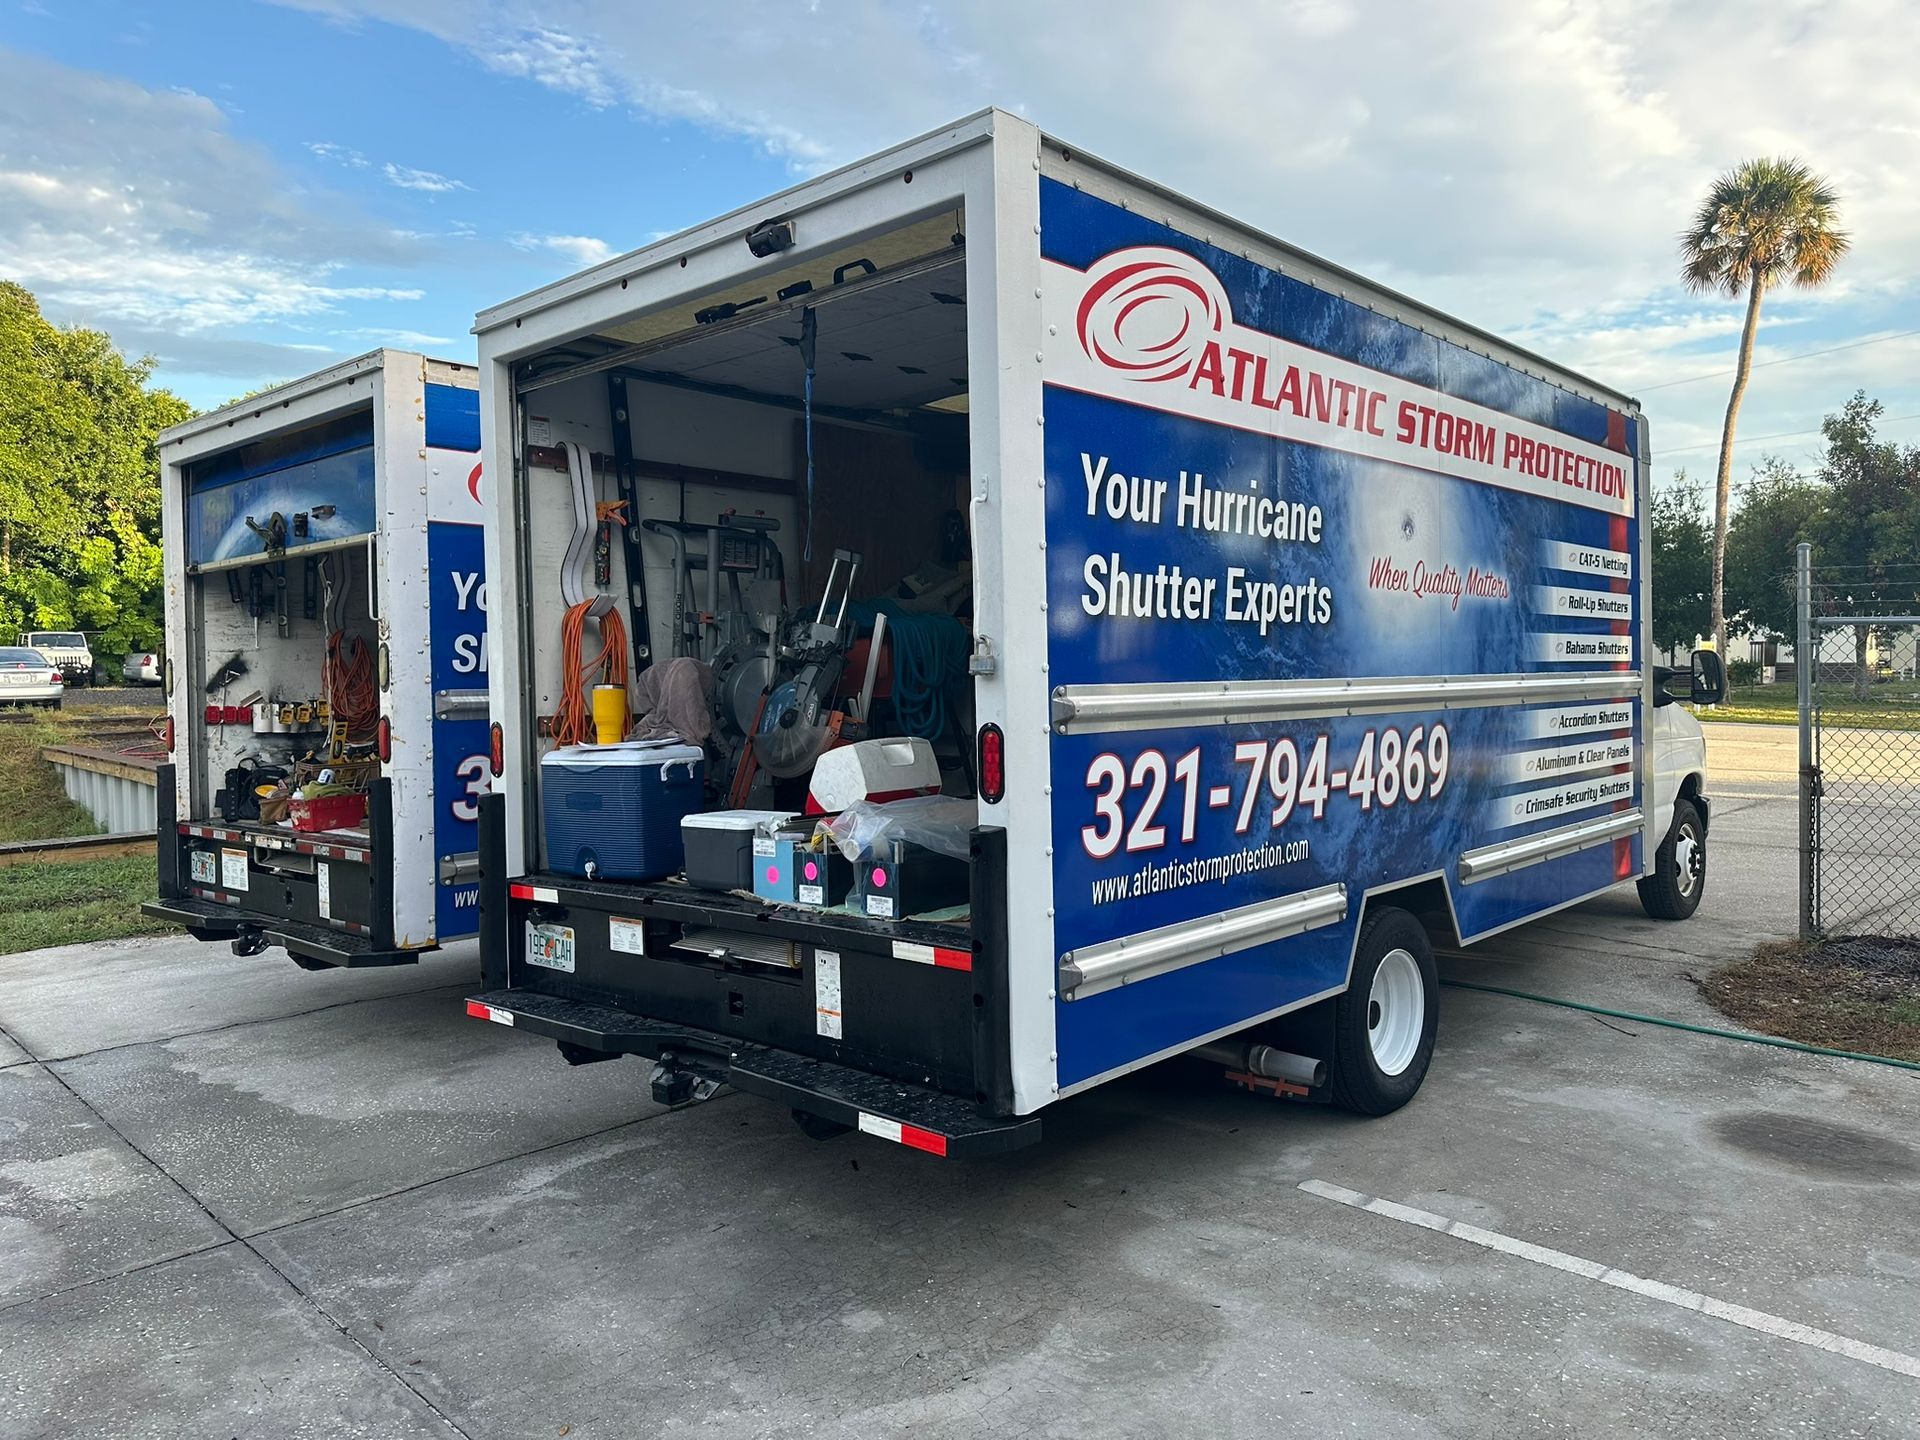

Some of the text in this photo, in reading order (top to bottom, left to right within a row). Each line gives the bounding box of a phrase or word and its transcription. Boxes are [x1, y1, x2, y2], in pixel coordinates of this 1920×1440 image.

[1189, 340, 1627, 500] ATLANTIC STORM PROTECTION
[1081, 452, 1323, 543] Your Hurricane
[1369, 556, 1508, 611] When Quality Matters
[1602, 556, 1628, 574] Netting
[1081, 552, 1332, 636] Shutter Experts
[1568, 596, 1628, 613] Roll-Up Shutters
[1566, 641, 1628, 655] Bahama Shutters
[1559, 711, 1629, 728] Accordion Shutters
[1535, 744, 1630, 771] Aluminum & Clear Panels
[1081, 724, 1449, 858] 321-794-4869
[1526, 781, 1630, 814] Crimsafe Security Shutters
[1092, 838, 1309, 906] www.atlanticstormprotection.com
